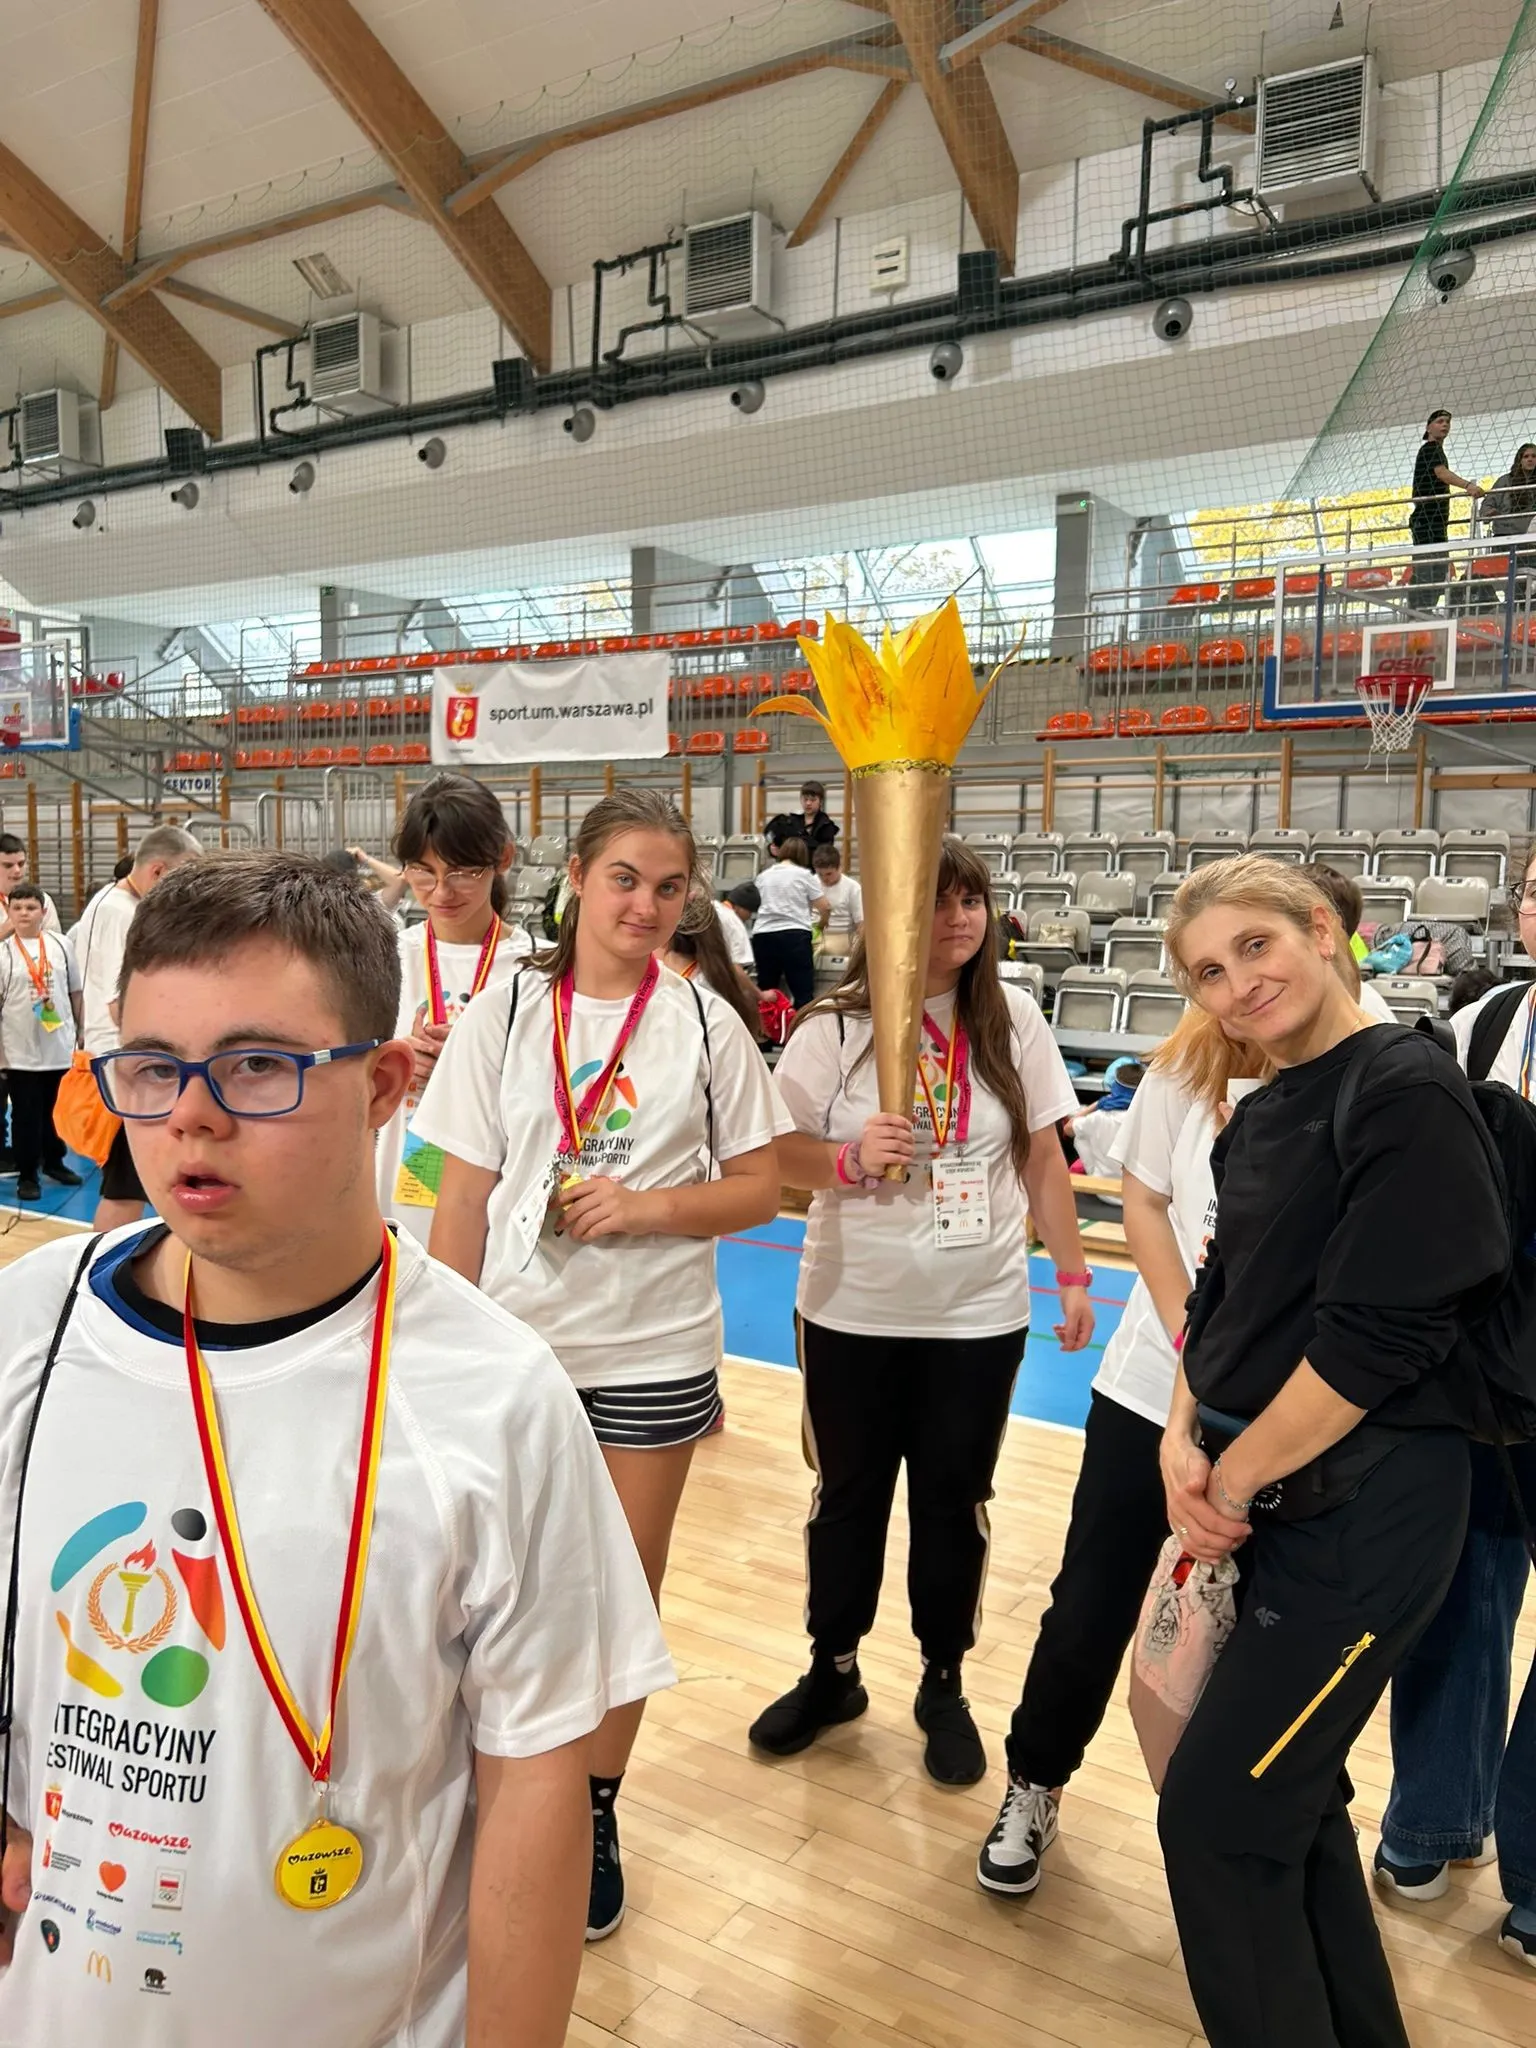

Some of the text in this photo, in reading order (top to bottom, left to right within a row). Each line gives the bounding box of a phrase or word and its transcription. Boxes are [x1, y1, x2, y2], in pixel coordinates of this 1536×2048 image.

[489, 698, 654, 724] sport.um.warszawa.pl
[1303, 1120, 1329, 1134] 4F
[1254, 1607, 1281, 1628] 4F
[121, 1764, 207, 1803] SPORTU
